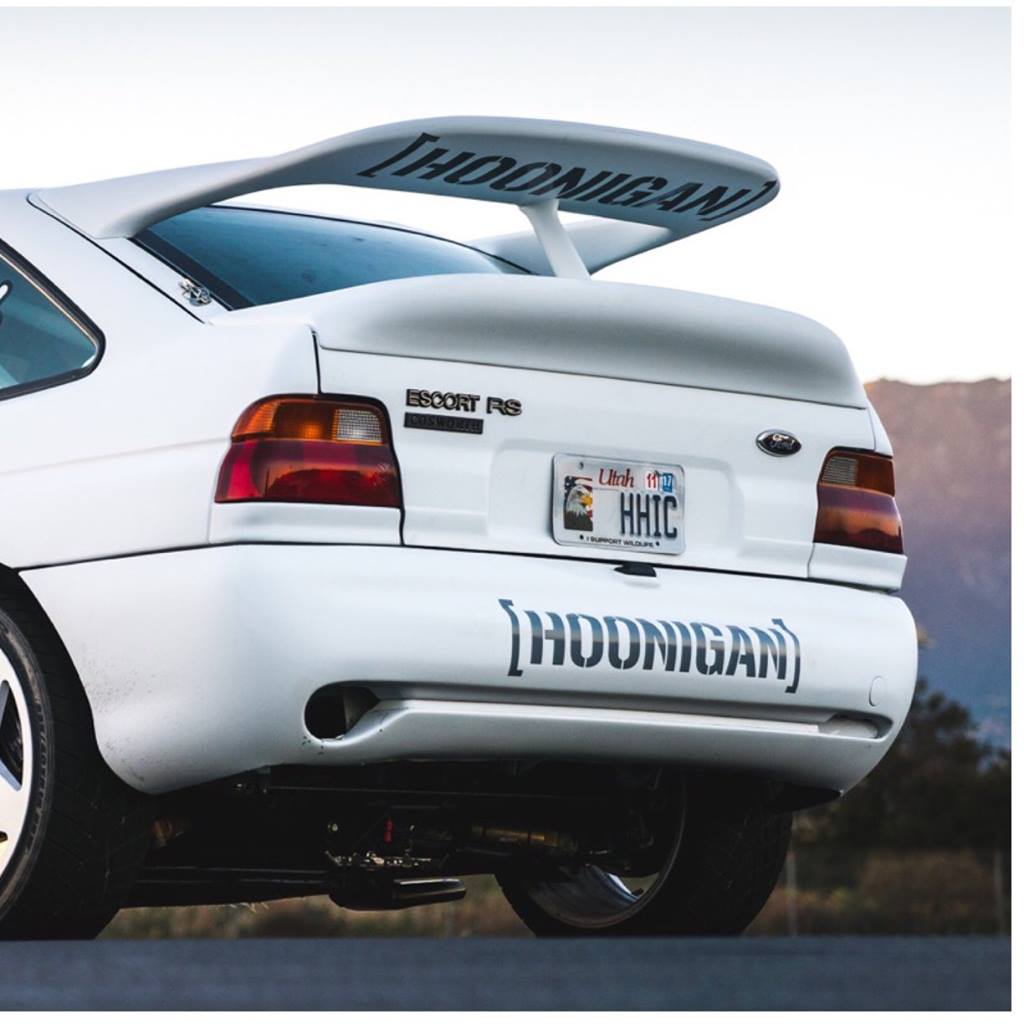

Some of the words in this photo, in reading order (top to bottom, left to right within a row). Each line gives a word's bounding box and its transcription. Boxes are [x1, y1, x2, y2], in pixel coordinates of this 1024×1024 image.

[405, 388, 481, 413] ESCORT
[486, 396, 523, 417] RS
[598, 467, 635, 489] Utah
[620, 492, 678, 540] HHIC
[590, 536, 622, 546] SUPPORT
[623, 539, 654, 548] WILDLIFE
